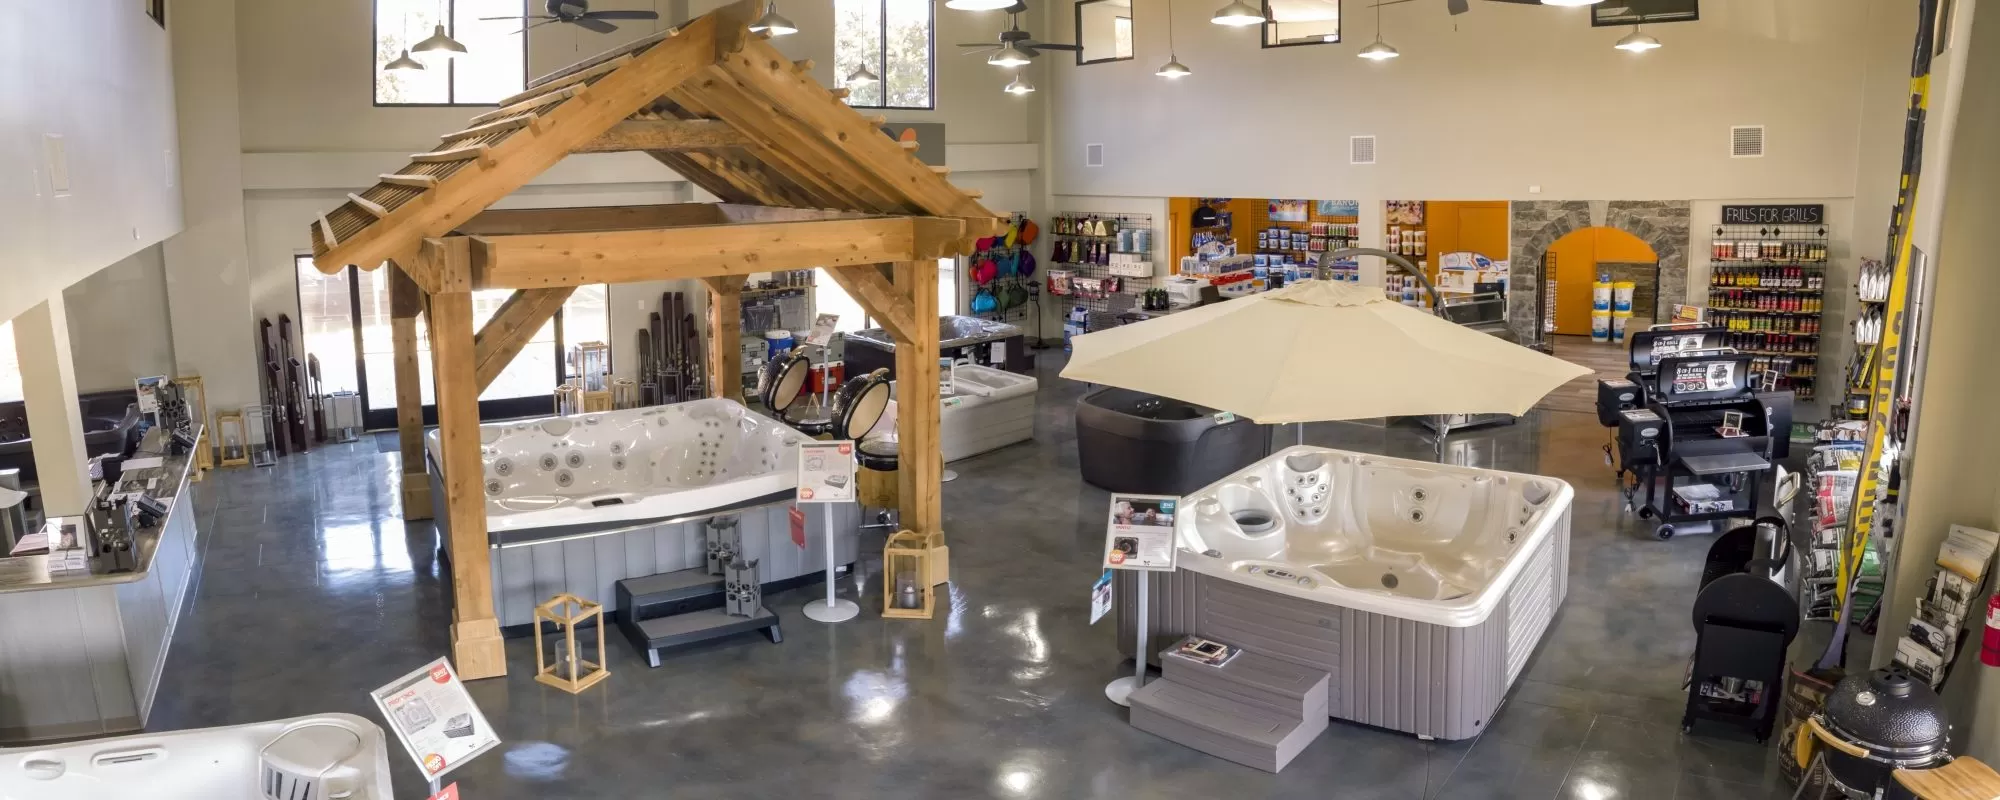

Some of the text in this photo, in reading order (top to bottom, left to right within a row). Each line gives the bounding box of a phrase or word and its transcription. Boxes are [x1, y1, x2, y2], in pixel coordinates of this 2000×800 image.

[1726, 207, 1818, 222] FRILLS FOR GRILLS
